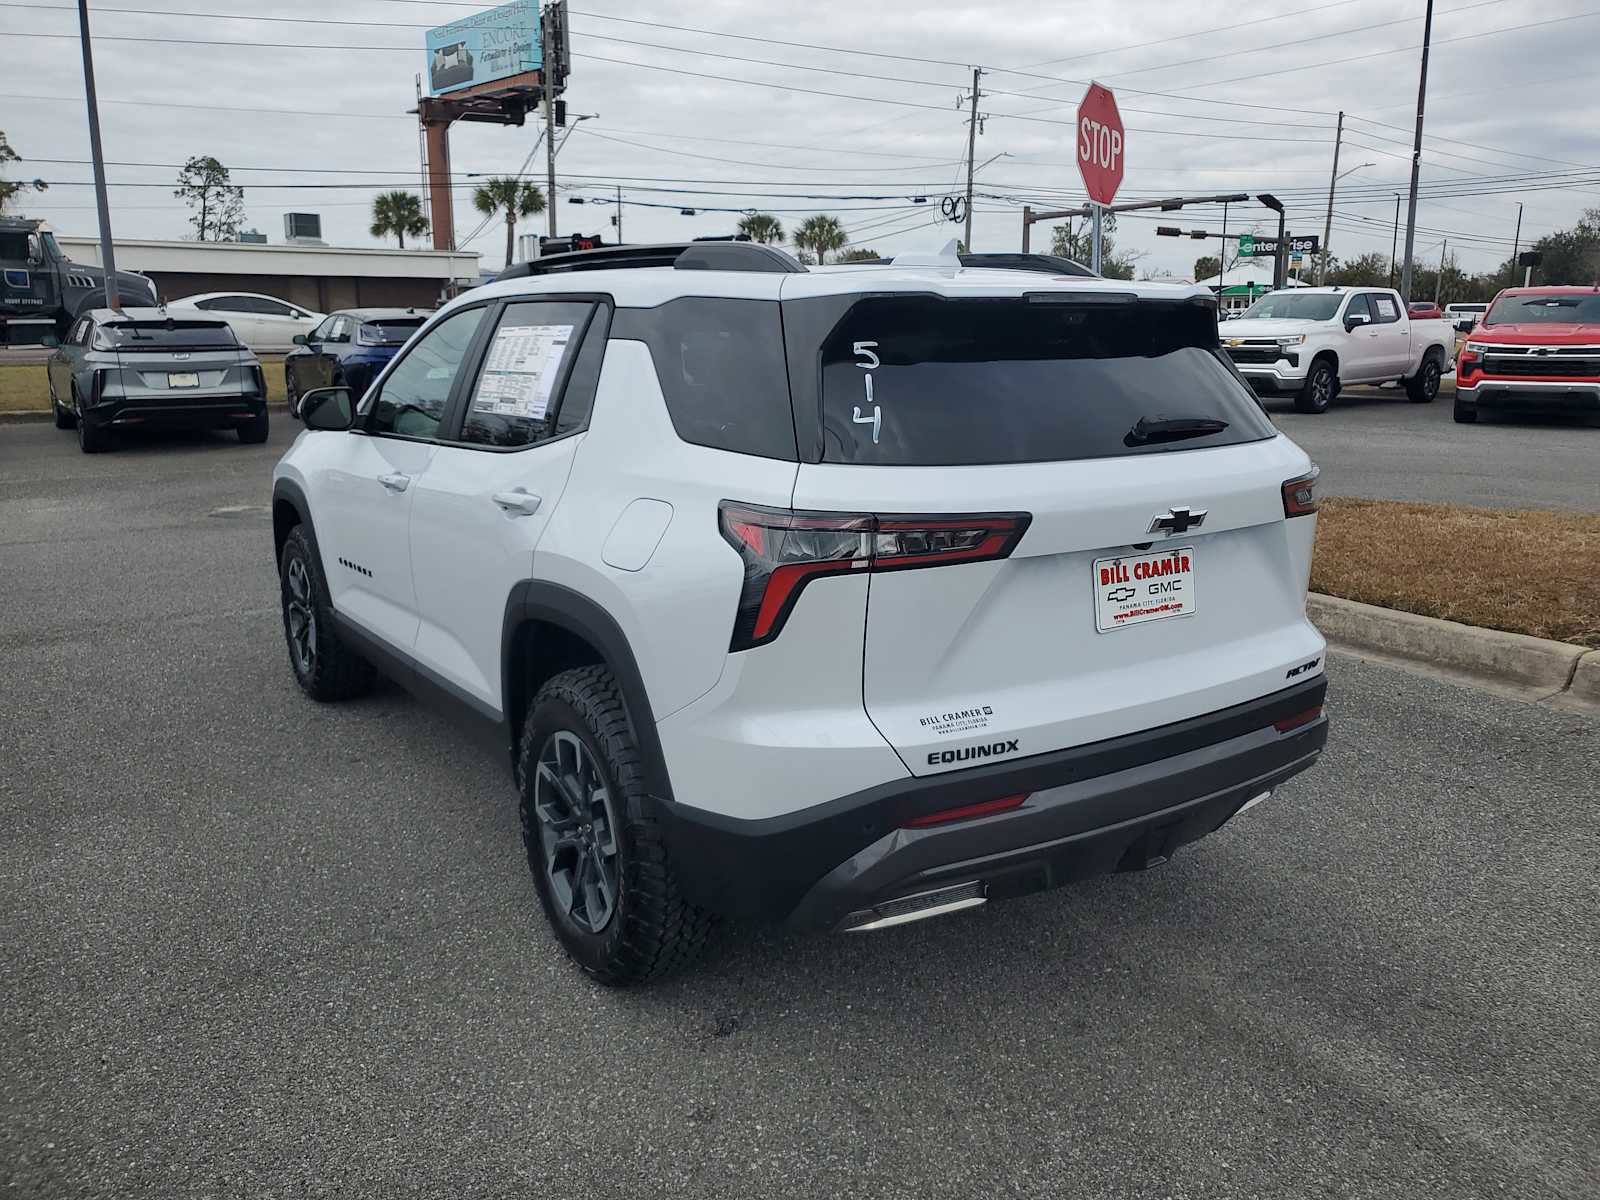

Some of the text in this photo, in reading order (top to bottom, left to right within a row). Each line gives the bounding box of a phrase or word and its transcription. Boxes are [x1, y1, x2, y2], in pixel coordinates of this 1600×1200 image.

[1080, 116, 1122, 171] STOP
[1240, 239, 1313, 253] enterrise
[1100, 556, 1190, 586] BILL CRAMER
[1148, 579, 1182, 595] GMC
[1119, 601, 1141, 610] PANAMA
[920, 715, 940, 726] BILL
[942, 708, 982, 722] CRAMER
[928, 739, 1019, 766] EQUINOX
